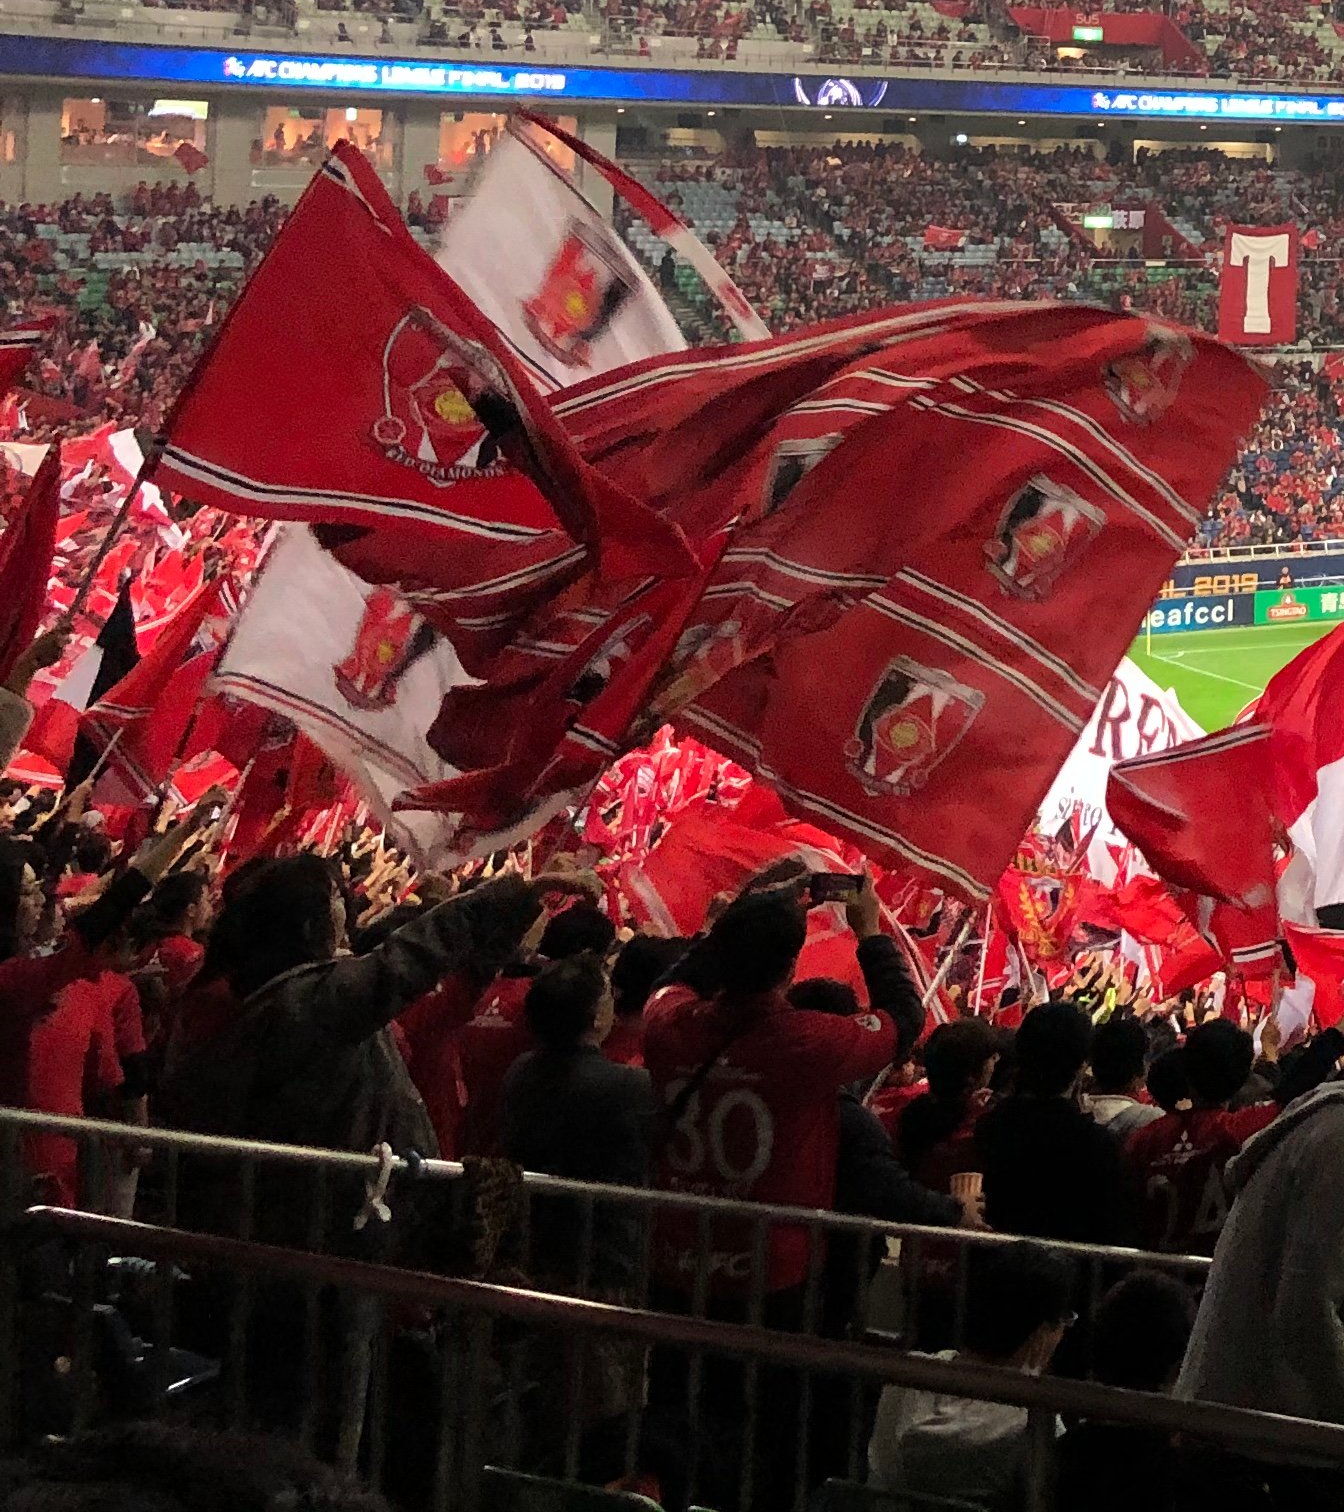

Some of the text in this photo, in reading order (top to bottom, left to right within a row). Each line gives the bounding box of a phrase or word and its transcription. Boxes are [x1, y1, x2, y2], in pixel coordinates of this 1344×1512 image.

[1194, 573, 1259, 596] 2019
[1141, 598, 1234, 628] eafccl
[664, 1080, 775, 1184] 30
